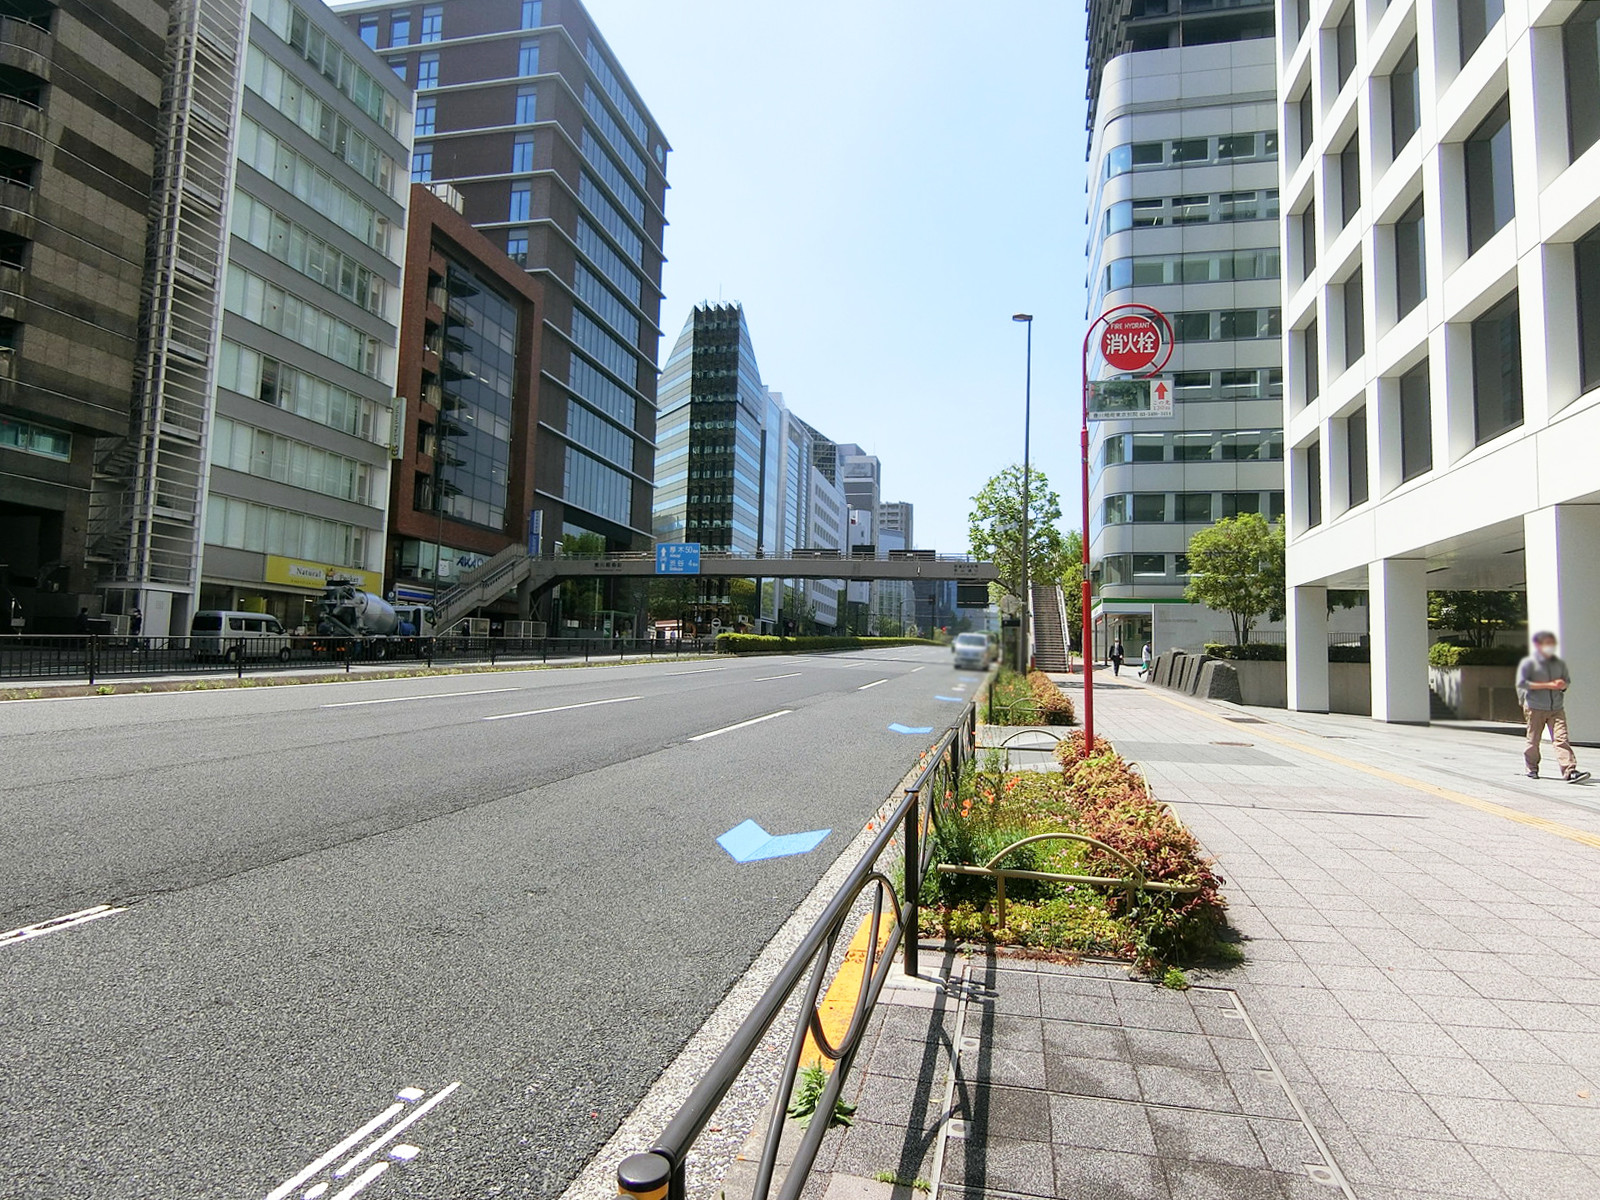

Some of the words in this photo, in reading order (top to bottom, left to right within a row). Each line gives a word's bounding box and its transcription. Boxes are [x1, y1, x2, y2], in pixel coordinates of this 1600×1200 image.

[1106, 332, 1156, 355] 消火栓
[296, 567, 322, 578] Natural
